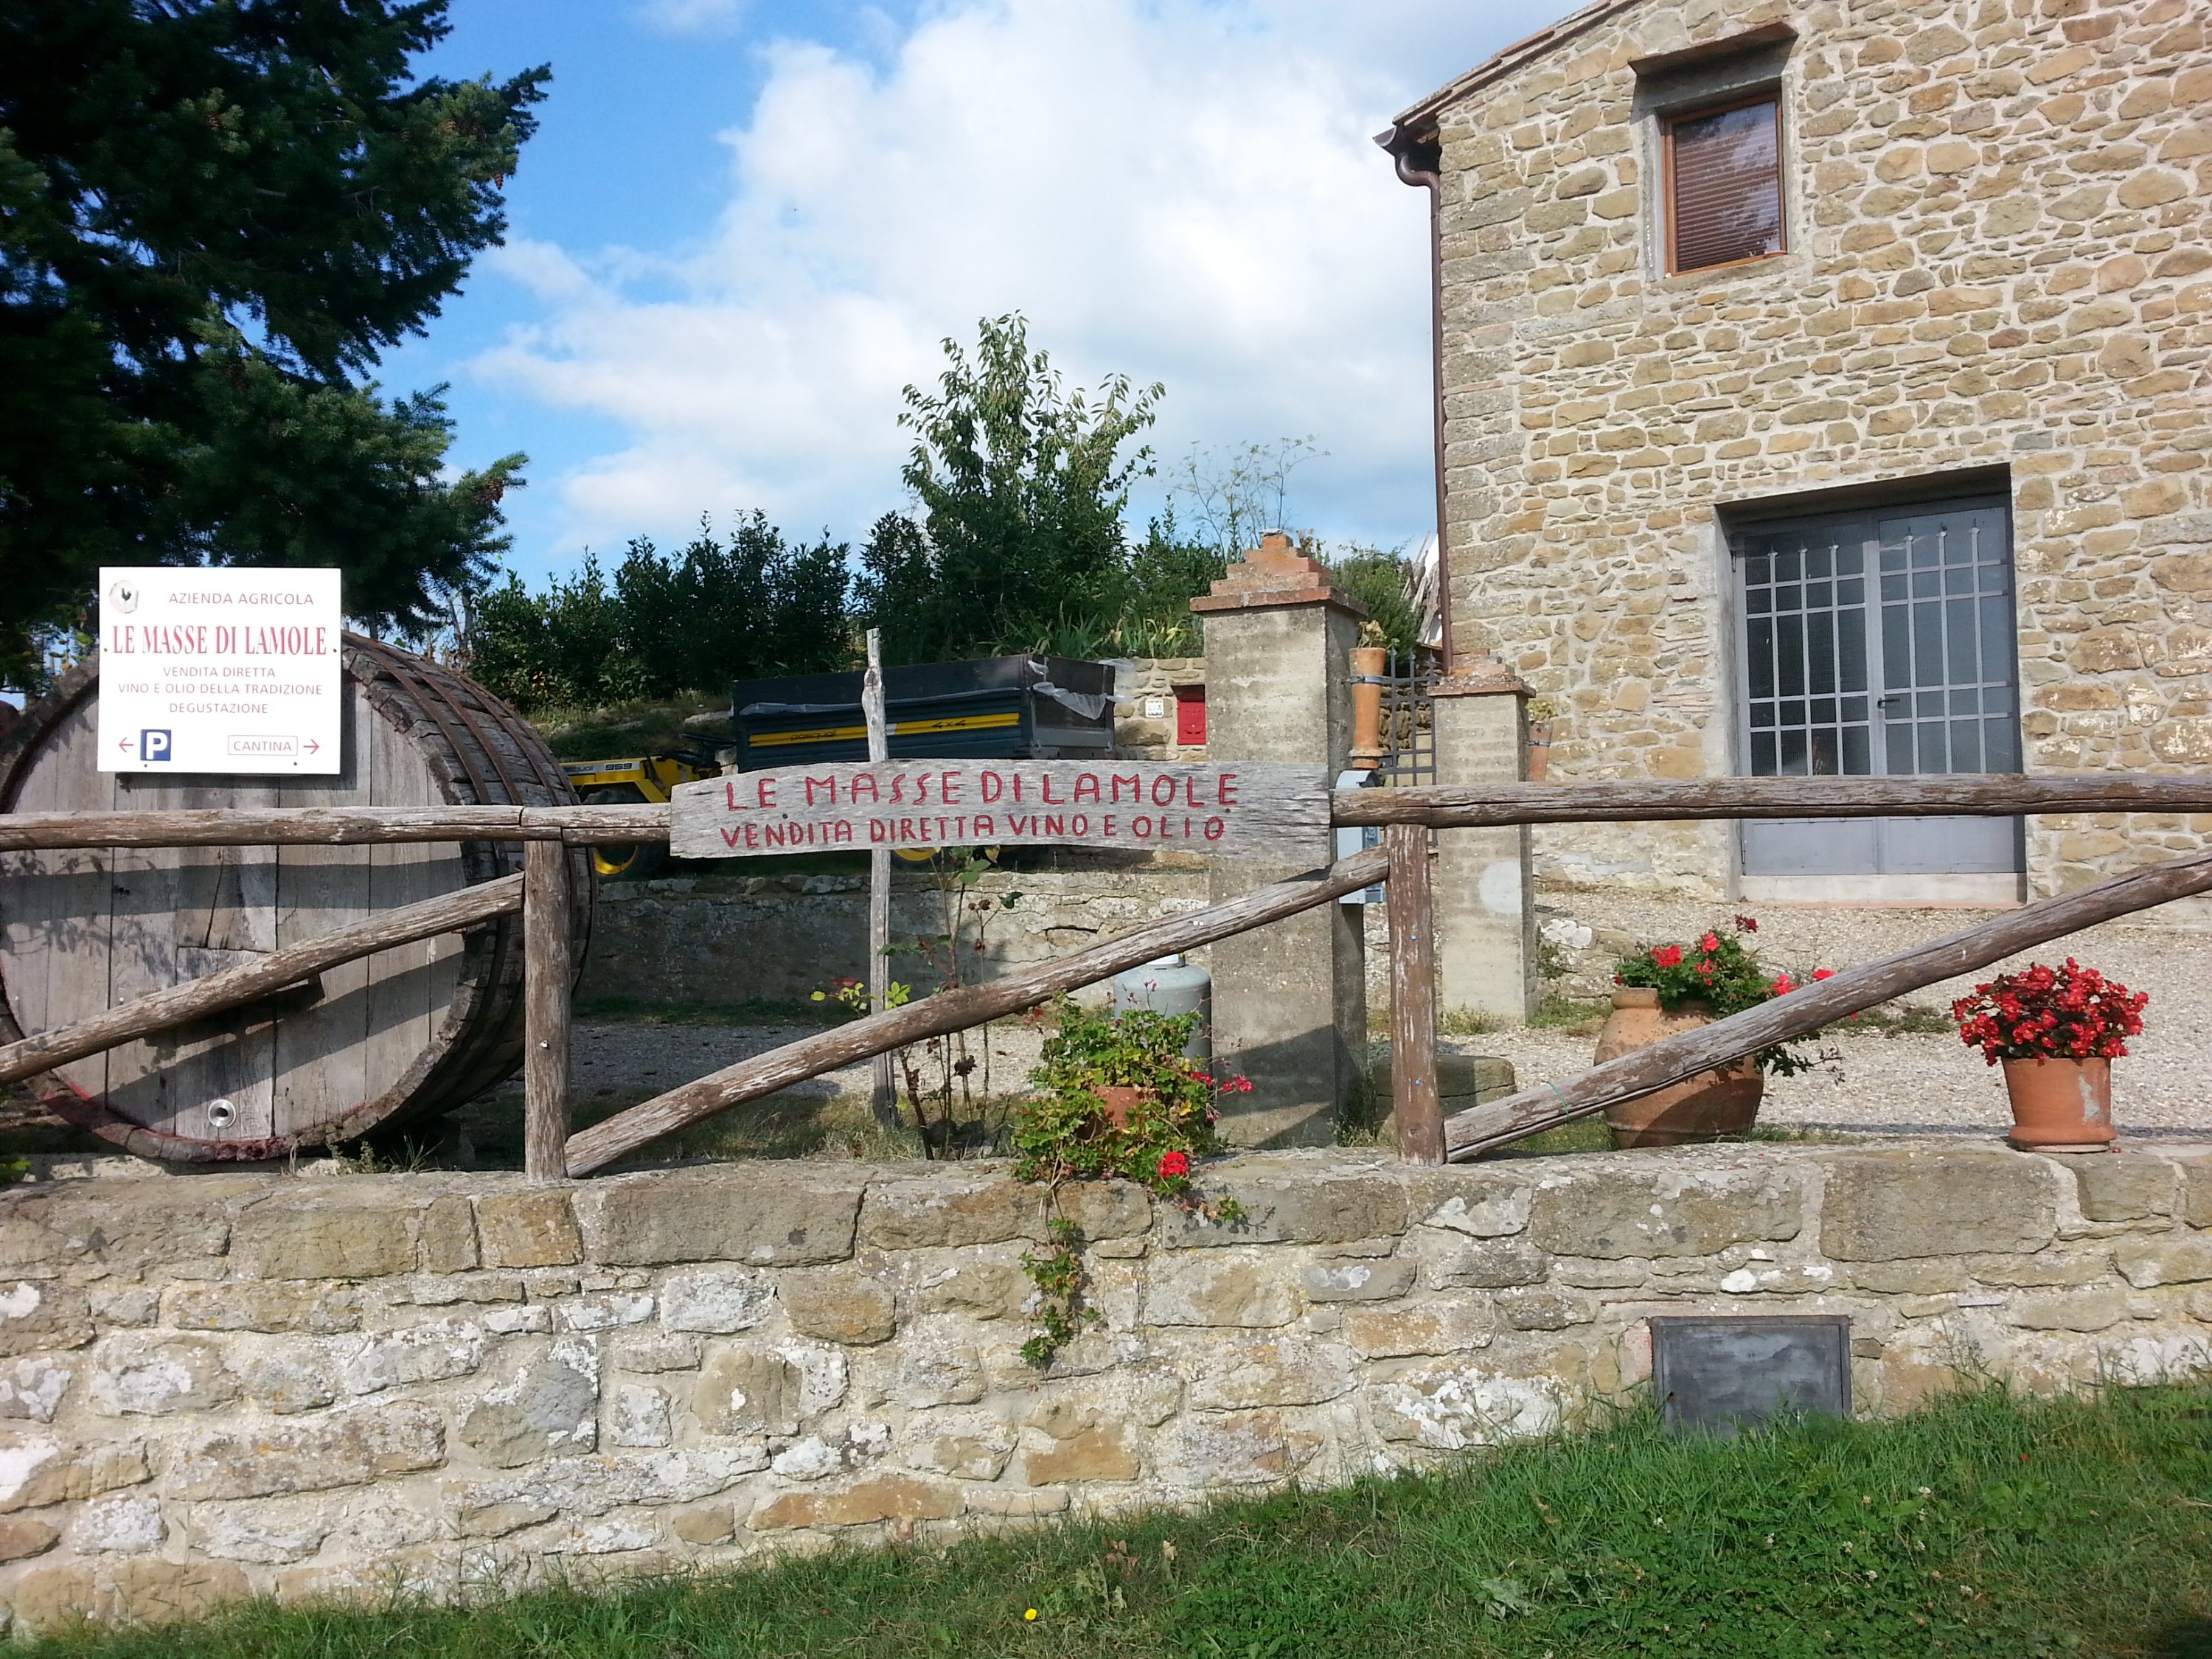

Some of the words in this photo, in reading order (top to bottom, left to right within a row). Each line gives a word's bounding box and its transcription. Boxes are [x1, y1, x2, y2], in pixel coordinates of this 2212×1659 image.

[169, 592, 233, 605] AZIENDA
[237, 593, 314, 605] AGRICOLA
[113, 625, 135, 654] LE
[142, 625, 207, 655] MASSE
[215, 625, 237, 655] DI
[244, 626, 327, 655] LAMOLE
[163, 667, 218, 677] VENDITA
[223, 667, 276, 678] DIRETTA
[118, 683, 149, 694] VINO
[153, 683, 161, 694] E
[165, 684, 195, 694] OLIO
[200, 684, 240, 694] DELLA
[245, 684, 321, 695] TRADIZIONE
[170, 703, 268, 714] DEGUSTAZIONE
[146, 732, 168, 759] P
[233, 740, 292, 751] CANTINA
[605, 762, 633, 771] 959
[727, 779, 774, 810] LE
[805, 771, 960, 804] MASSE
[981, 772, 1020, 803] DI
[1043, 774, 1236, 807] LAMOLE
[722, 821, 852, 848] VENDITA
[871, 815, 994, 843] DIRETTA
[1009, 815, 1088, 836] VINO
[1104, 815, 1116, 837] E
[1133, 816, 1224, 841] OLIO
